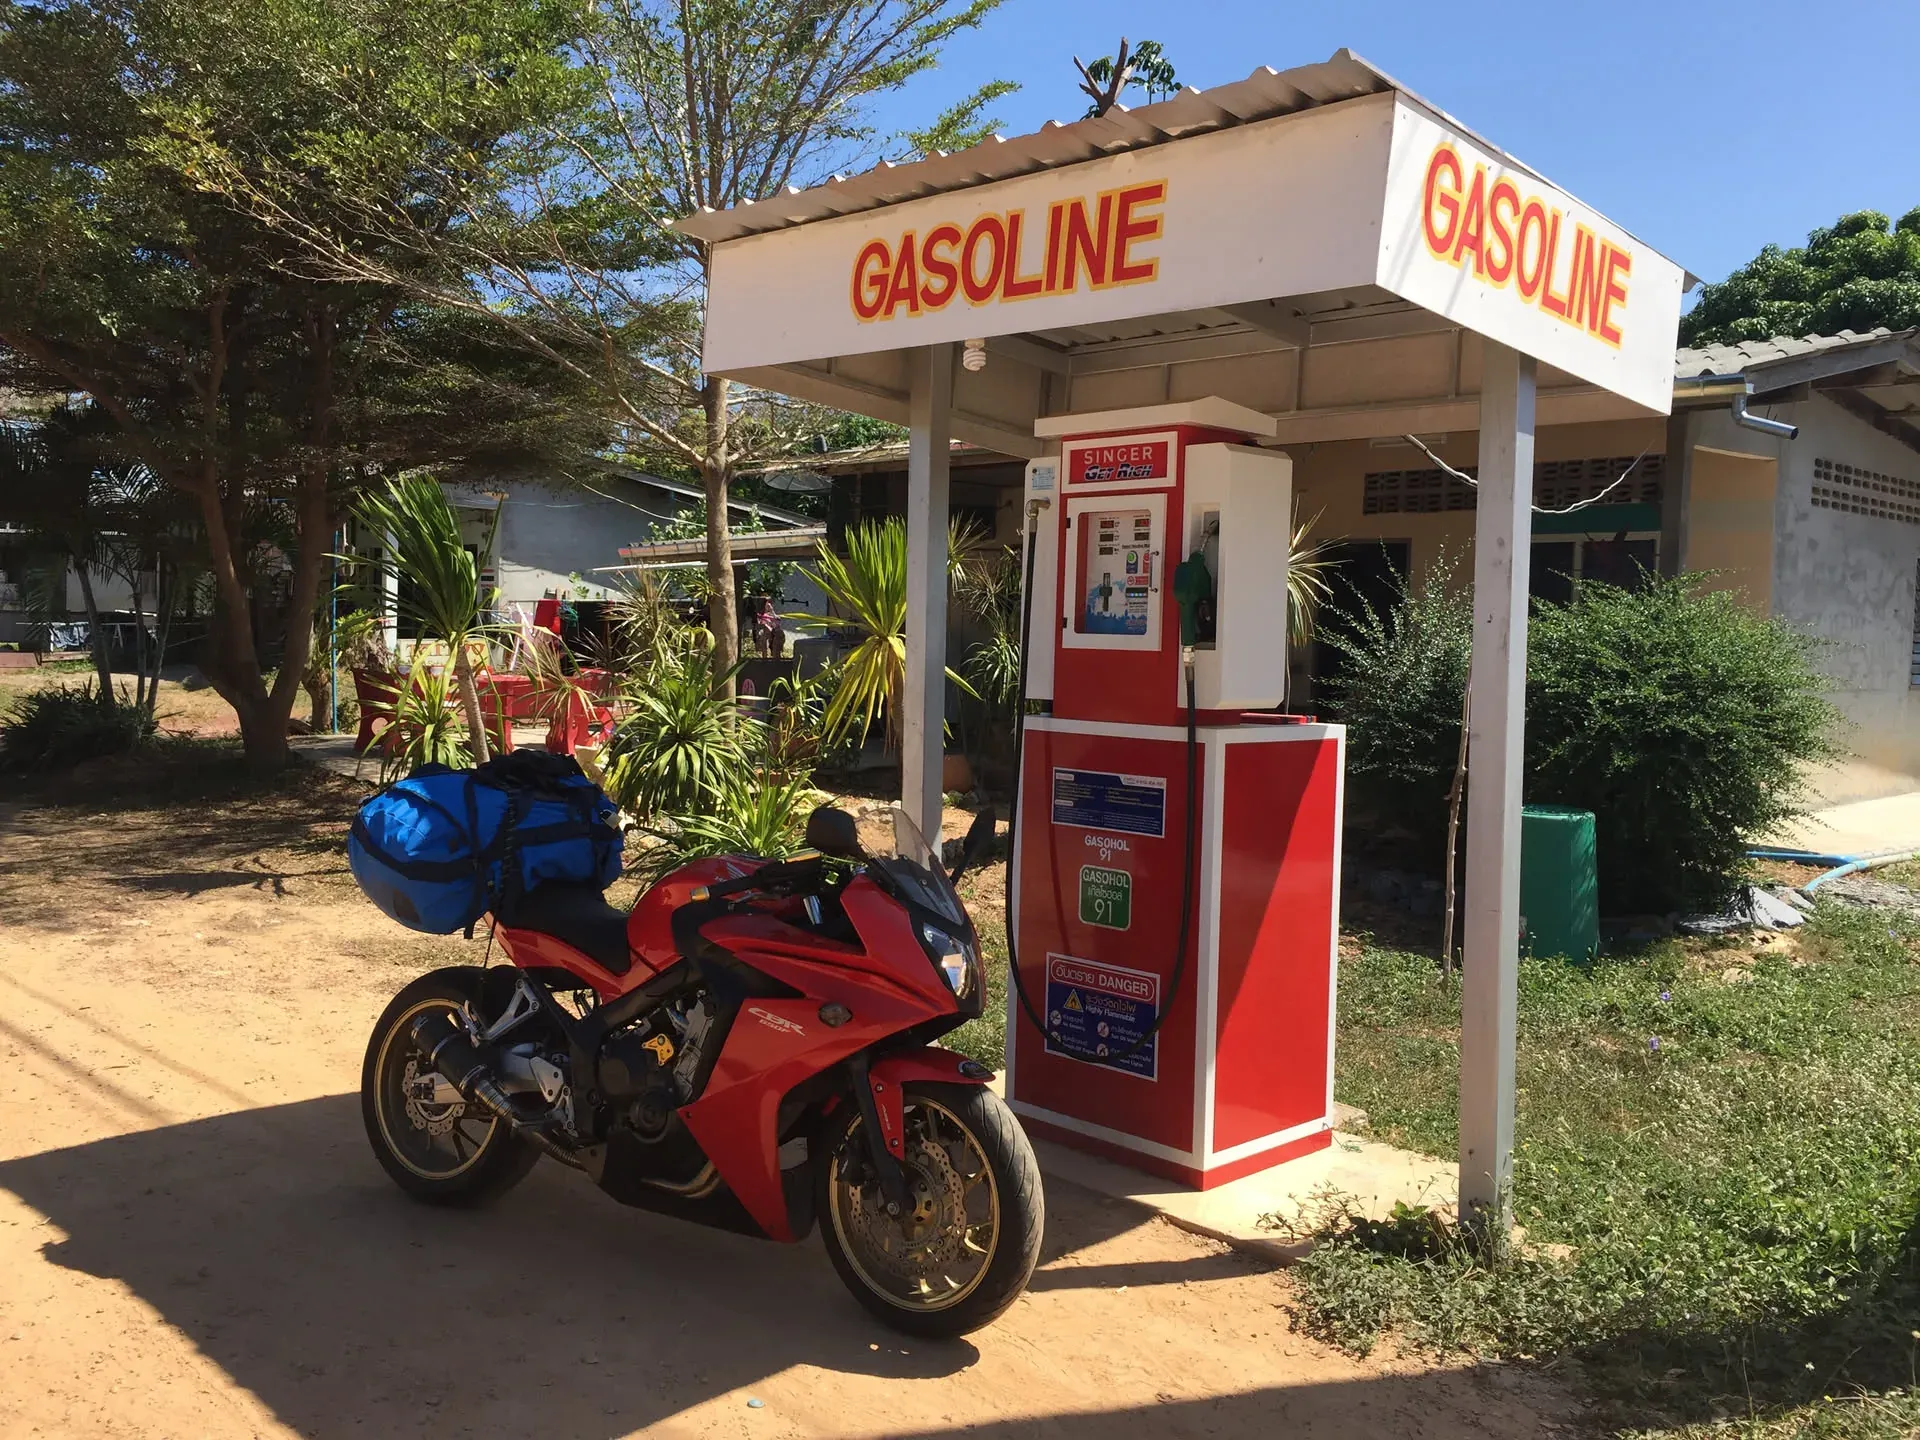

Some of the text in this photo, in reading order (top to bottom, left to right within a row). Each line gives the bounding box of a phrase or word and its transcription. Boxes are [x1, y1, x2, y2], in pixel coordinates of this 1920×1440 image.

[851, 178, 1168, 323] GASOLINE
[1421, 141, 1632, 350] GASOLINE
[1084, 446, 1153, 465] SINGER
[1084, 835, 1130, 852] GASOHOL
[1100, 848, 1112, 862] 91
[1082, 869, 1128, 888] GASOHOL
[1094, 898, 1112, 924] 91
[1055, 965, 1149, 996] อันตราย DANGER
[747, 1007, 806, 1037] CBR
